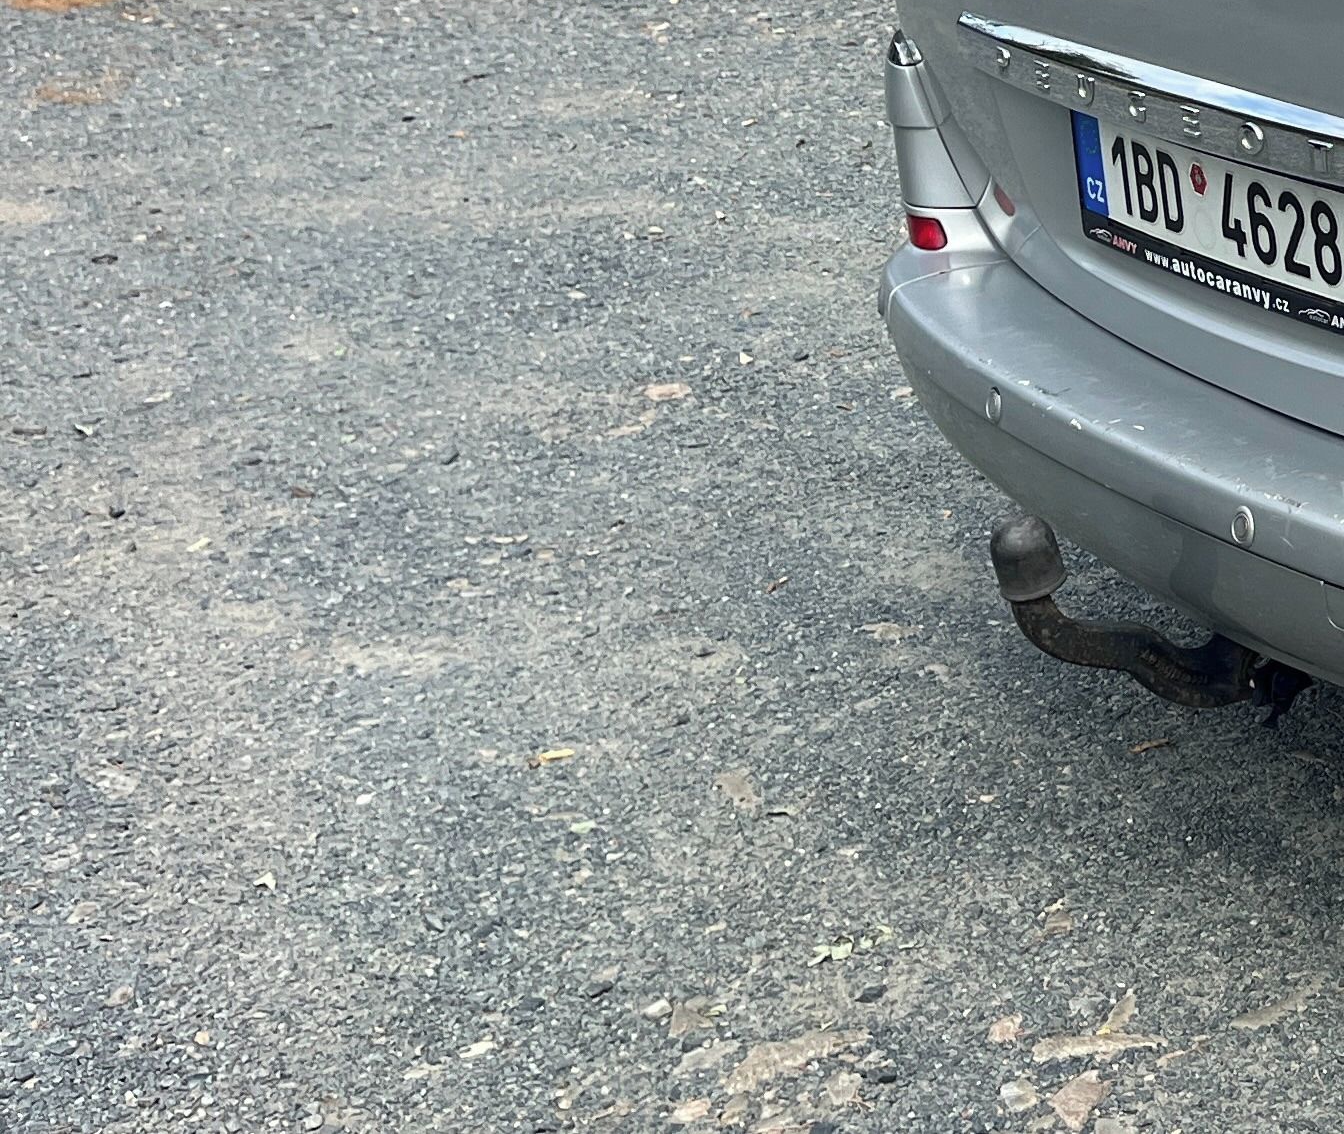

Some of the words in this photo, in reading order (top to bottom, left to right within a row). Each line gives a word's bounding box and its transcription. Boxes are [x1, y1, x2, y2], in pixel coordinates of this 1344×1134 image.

[996, 46, 1335, 174] PEUGEOT
[1087, 176, 1105, 203] CZ
[1111, 136, 1184, 233] 1BD
[1221, 173, 1342, 286] 4628
[1144, 247, 1290, 313] www.autocaranvy.cz
